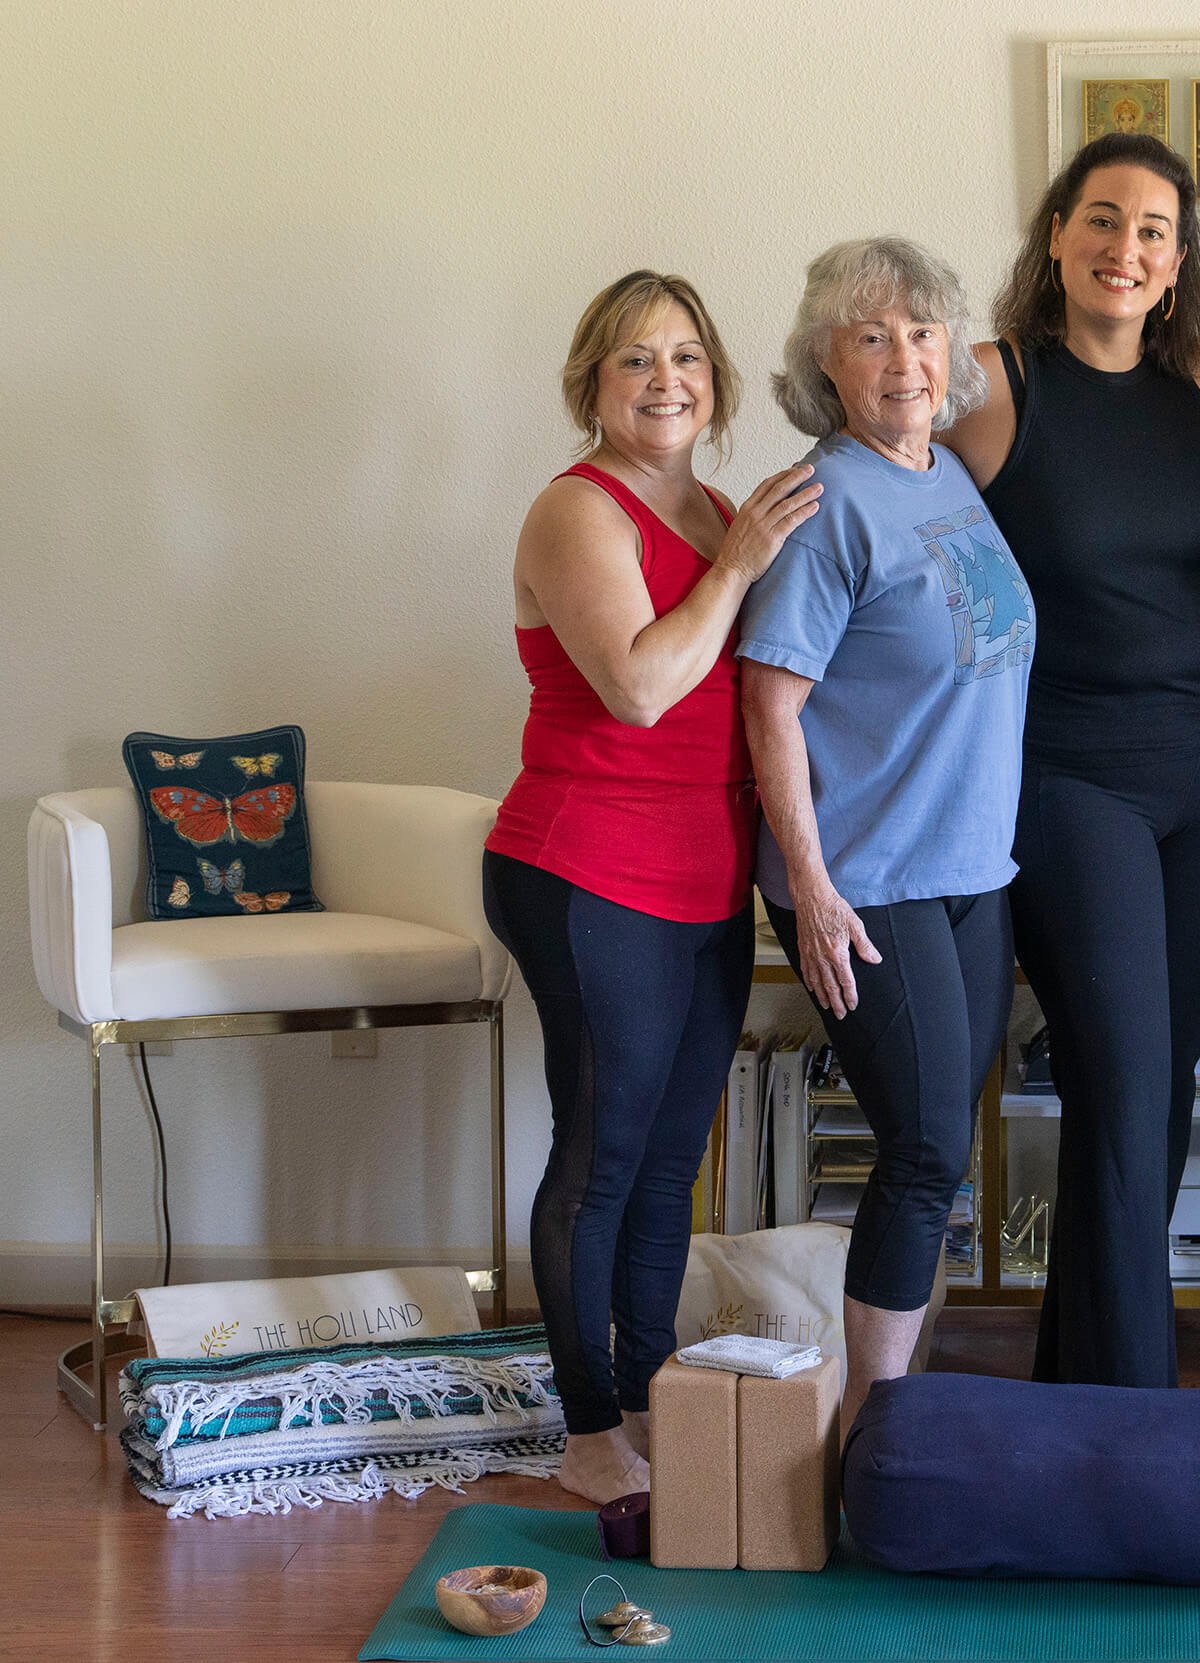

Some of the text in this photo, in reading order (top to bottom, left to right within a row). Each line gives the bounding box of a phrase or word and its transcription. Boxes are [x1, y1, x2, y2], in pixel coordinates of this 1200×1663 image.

[253, 1303, 423, 1350] THE HOLI LAND
[754, 1313, 788, 1342] THE
